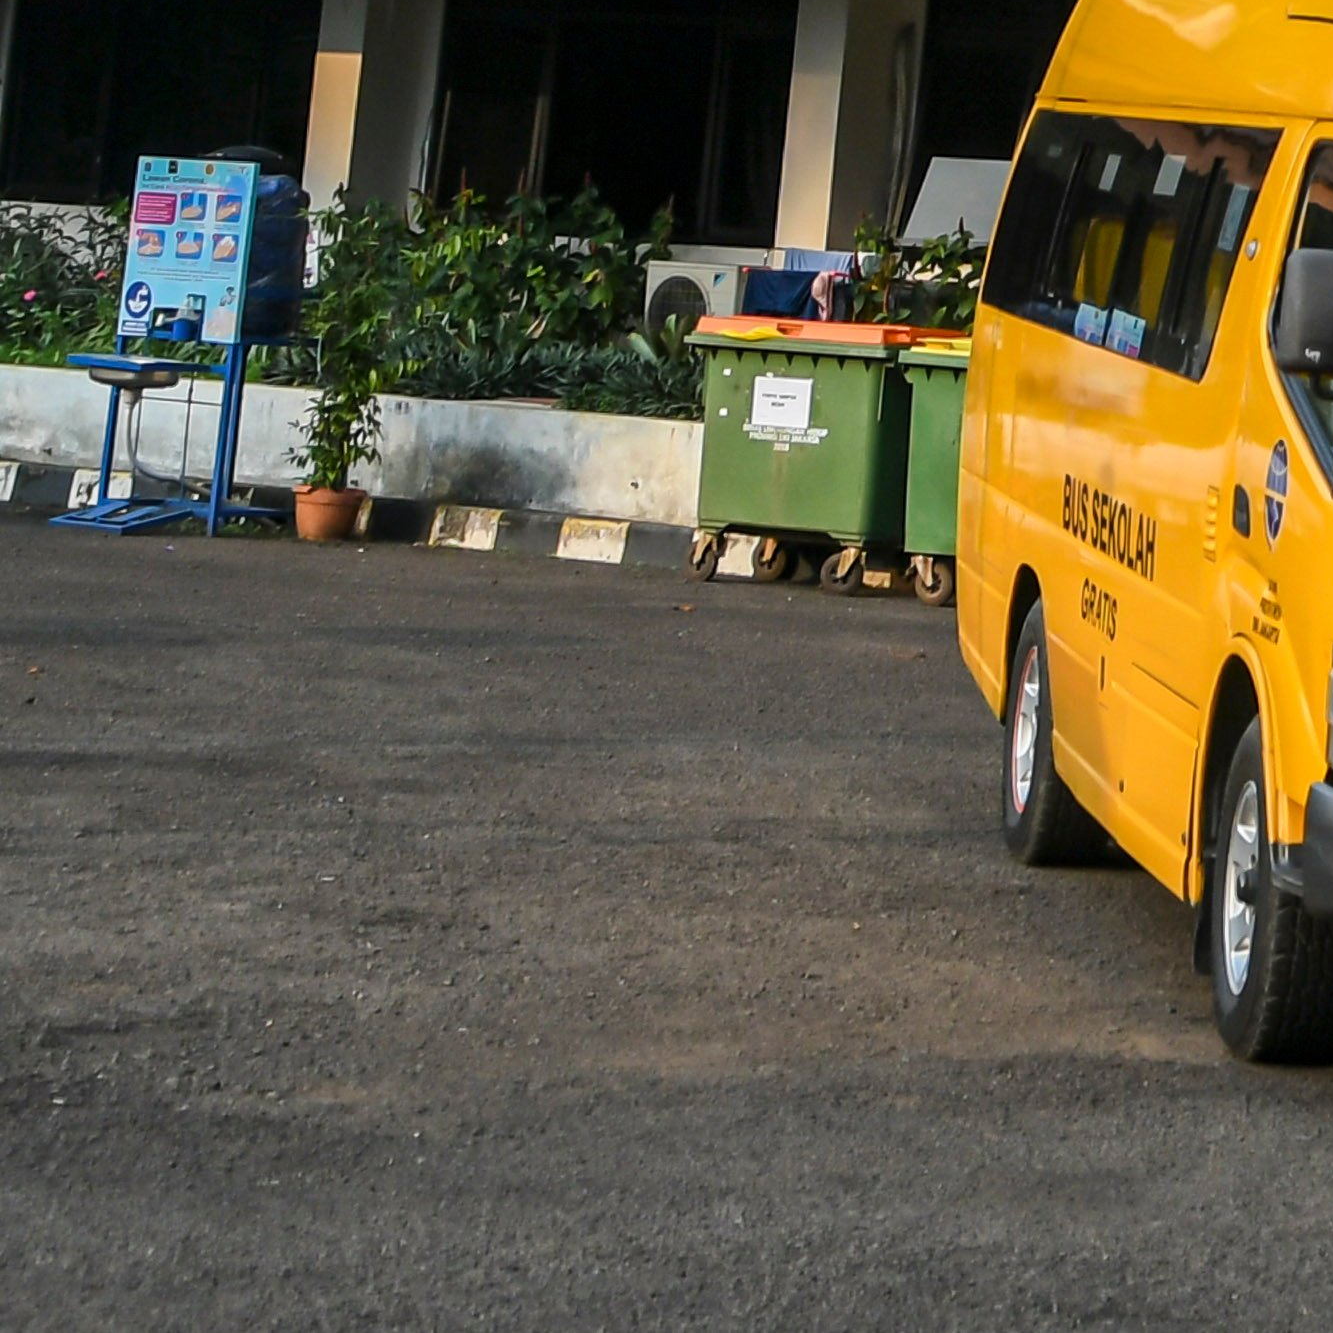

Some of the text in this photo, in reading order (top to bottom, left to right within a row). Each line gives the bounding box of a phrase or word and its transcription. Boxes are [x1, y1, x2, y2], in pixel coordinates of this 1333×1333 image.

[1063, 474, 1156, 582] BUS SEKOLAH
[1081, 577, 1118, 642] GRATIS
